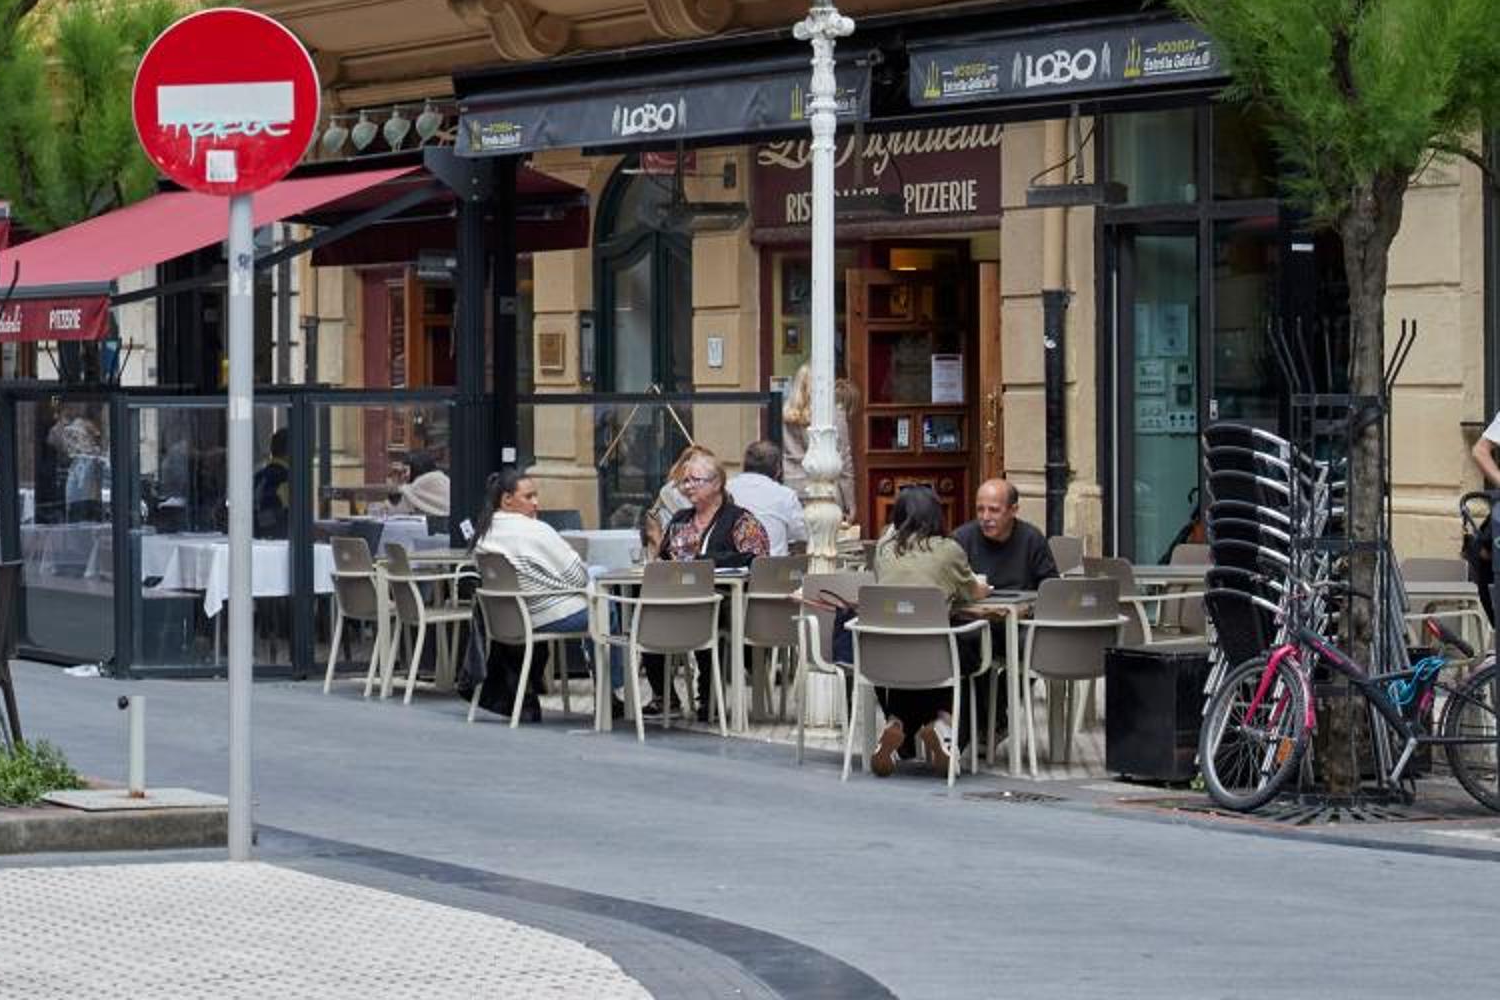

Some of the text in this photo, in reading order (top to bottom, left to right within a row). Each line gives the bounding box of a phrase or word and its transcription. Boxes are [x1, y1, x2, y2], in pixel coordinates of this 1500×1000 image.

[1025, 48, 1097, 89] LOBO
[621, 102, 676, 136] LOBO
[903, 179, 978, 215] PIZZERIE
